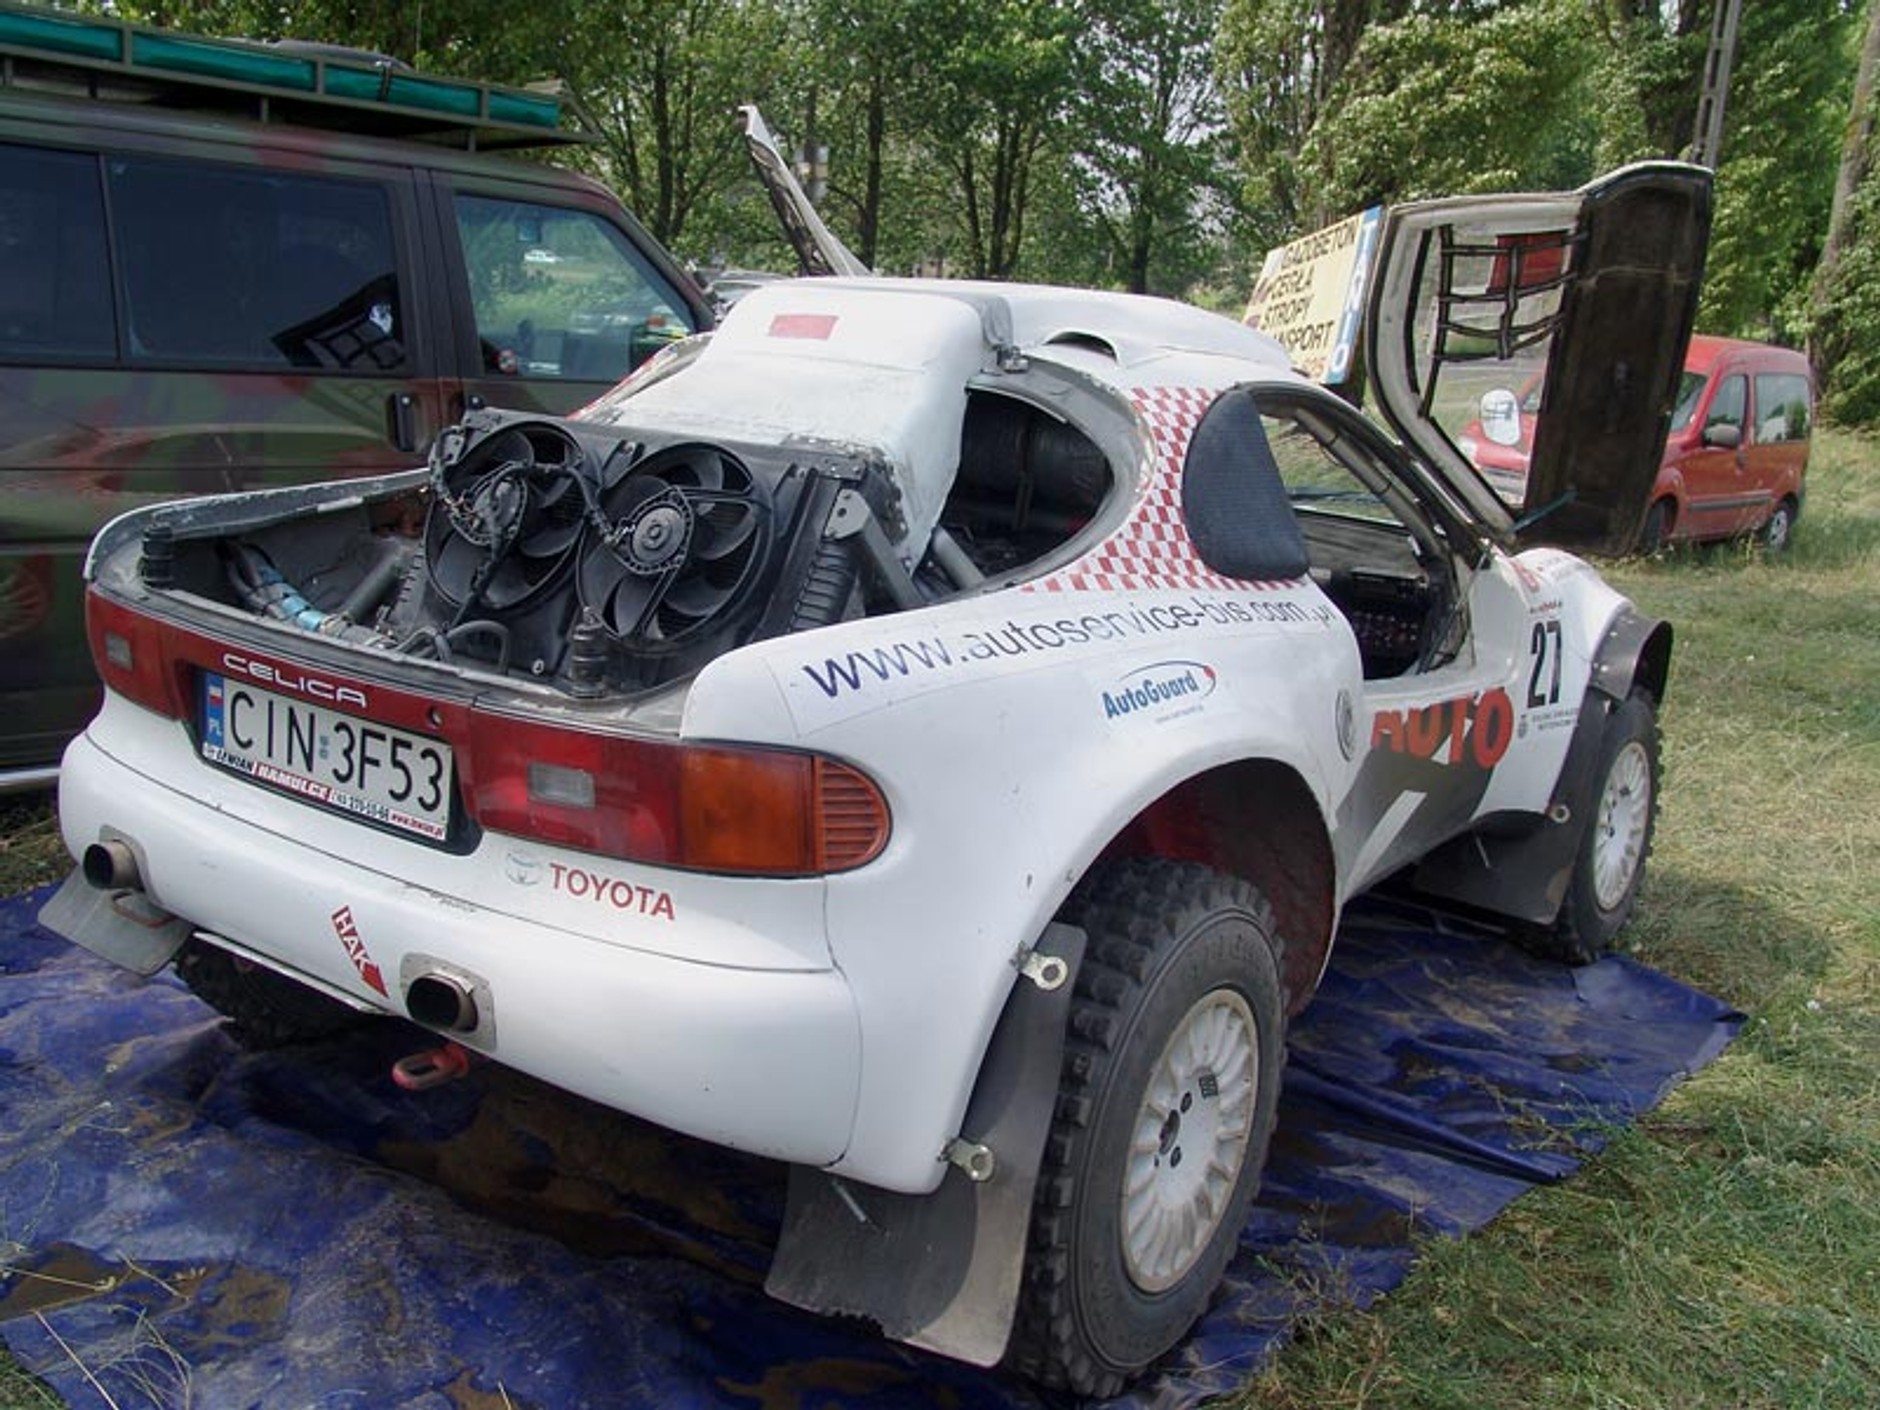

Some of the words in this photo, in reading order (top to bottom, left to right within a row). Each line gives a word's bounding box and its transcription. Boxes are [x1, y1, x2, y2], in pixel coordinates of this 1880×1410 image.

[1260, 296, 1315, 331] STROPY
[223, 654, 367, 708] CELICA
[1101, 669, 1200, 719] AutoGuard
[1527, 620, 1563, 709] 27
[208, 718, 222, 736] PL
[230, 690, 316, 773] CIN
[332, 721, 443, 812] 3F53
[1370, 686, 1515, 770] AUTO
[549, 862, 676, 921] TOYOTA
[335, 911, 370, 972] HAK
